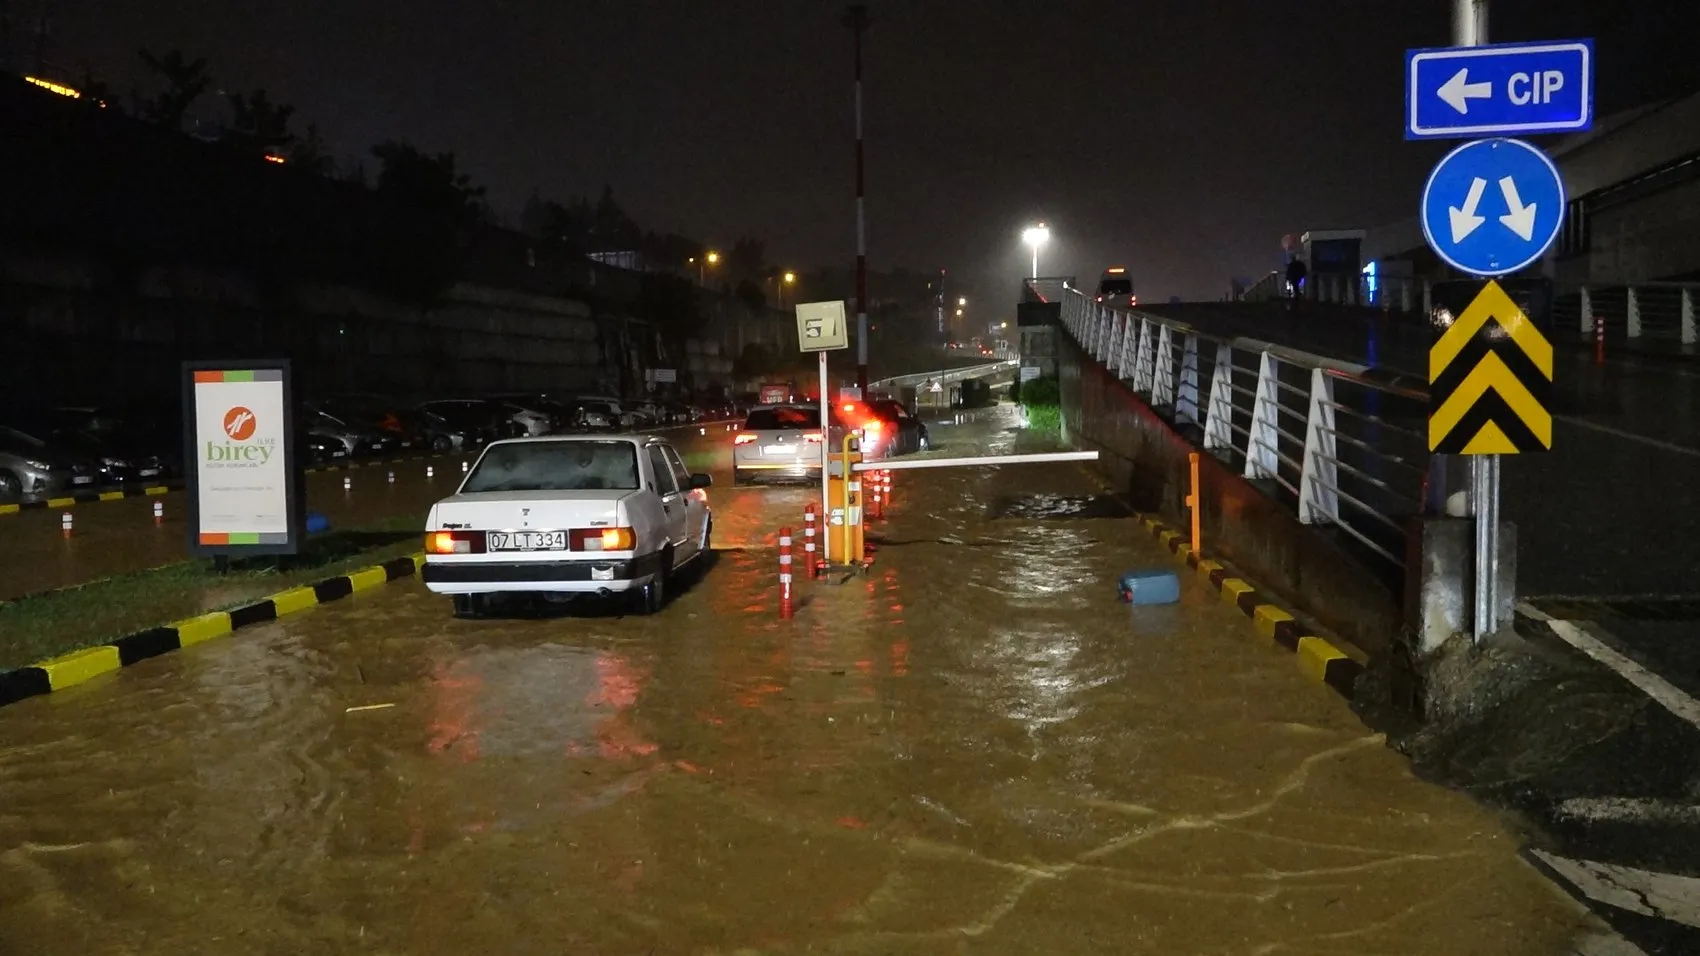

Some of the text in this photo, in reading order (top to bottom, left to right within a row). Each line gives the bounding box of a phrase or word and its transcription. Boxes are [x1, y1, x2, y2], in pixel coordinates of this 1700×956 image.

[1507, 70, 1565, 106] CIP
[207, 440, 275, 464] birey
[491, 533, 564, 548] 07 LT 334
